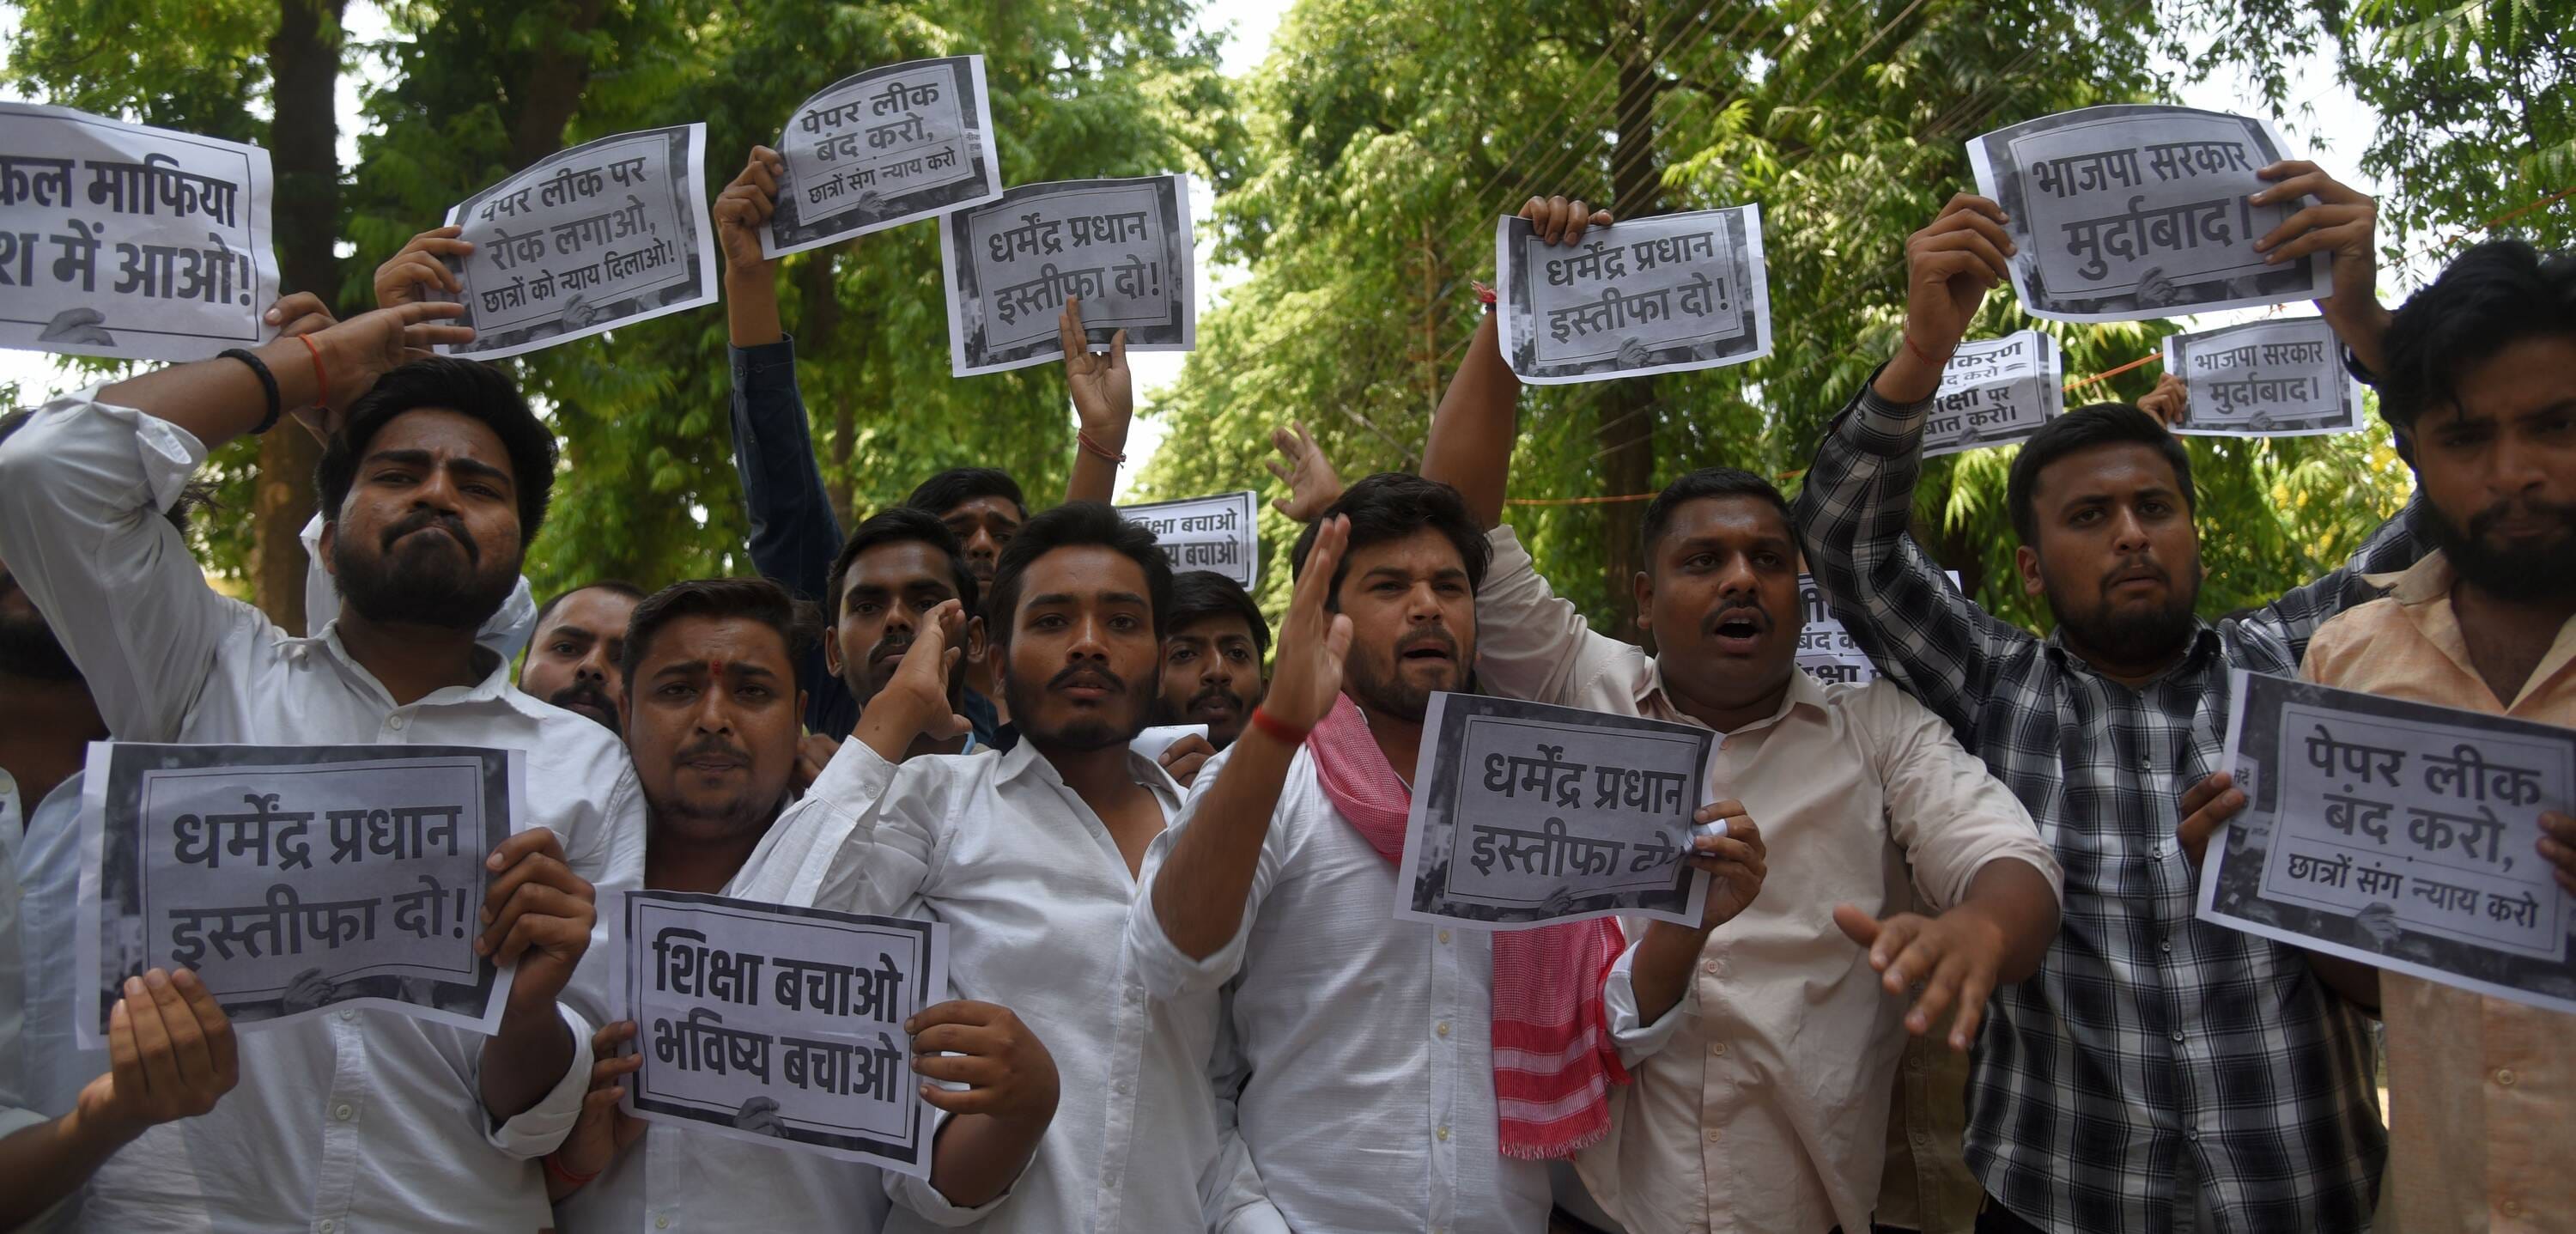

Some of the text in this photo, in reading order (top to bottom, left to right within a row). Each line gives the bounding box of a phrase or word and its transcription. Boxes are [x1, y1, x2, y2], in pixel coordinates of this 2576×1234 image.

[800, 82, 939, 135] पेपर लीक
[814, 112, 933, 162] बंद करो,
[84, 153, 238, 228] माफिया
[539, 168, 604, 208] लीक
[609, 156, 647, 187] पर
[808, 146, 956, 204] छात्रों संग न्याय करो
[2032, 142, 2254, 198] भाजपा सरकार
[50, 218, 105, 292] में
[114, 232, 251, 307] आओ!
[485, 194, 656, 271] रोक लगाओ,
[988, 211, 1147, 263] धर्मेंद्र प्रधान
[1546, 232, 1714, 286] धर्मेंद्र प्रधान
[481, 237, 676, 313] छात्रों को न्याय दिलाओ!
[993, 253, 1159, 326] इस्तीफा दो!
[1547, 272, 1728, 344] इस्तीफा दो!
[2195, 341, 2324, 370] भाजपा सरकार
[1986, 386, 2010, 401] पर
[1181, 508, 1237, 532] बचाओ
[1184, 534, 1238, 567] बचाओ
[1484, 744, 1687, 816] धर्मेंद्र प्रधान
[2305, 724, 2542, 807] पेपर लीक
[173, 793, 463, 872] धर्मेंद्र प्रधान
[1470, 817, 1625, 878] इस्तीफा
[2323, 784, 2514, 872] बंद करो,
[169, 875, 466, 972] इस्तीफा दो!
[2287, 853, 2540, 929] छात्रों संग न्याय करो
[652, 927, 903, 1024] शिक्षा बचाओ
[653, 1006, 902, 1103] भविष्य बचाओ
